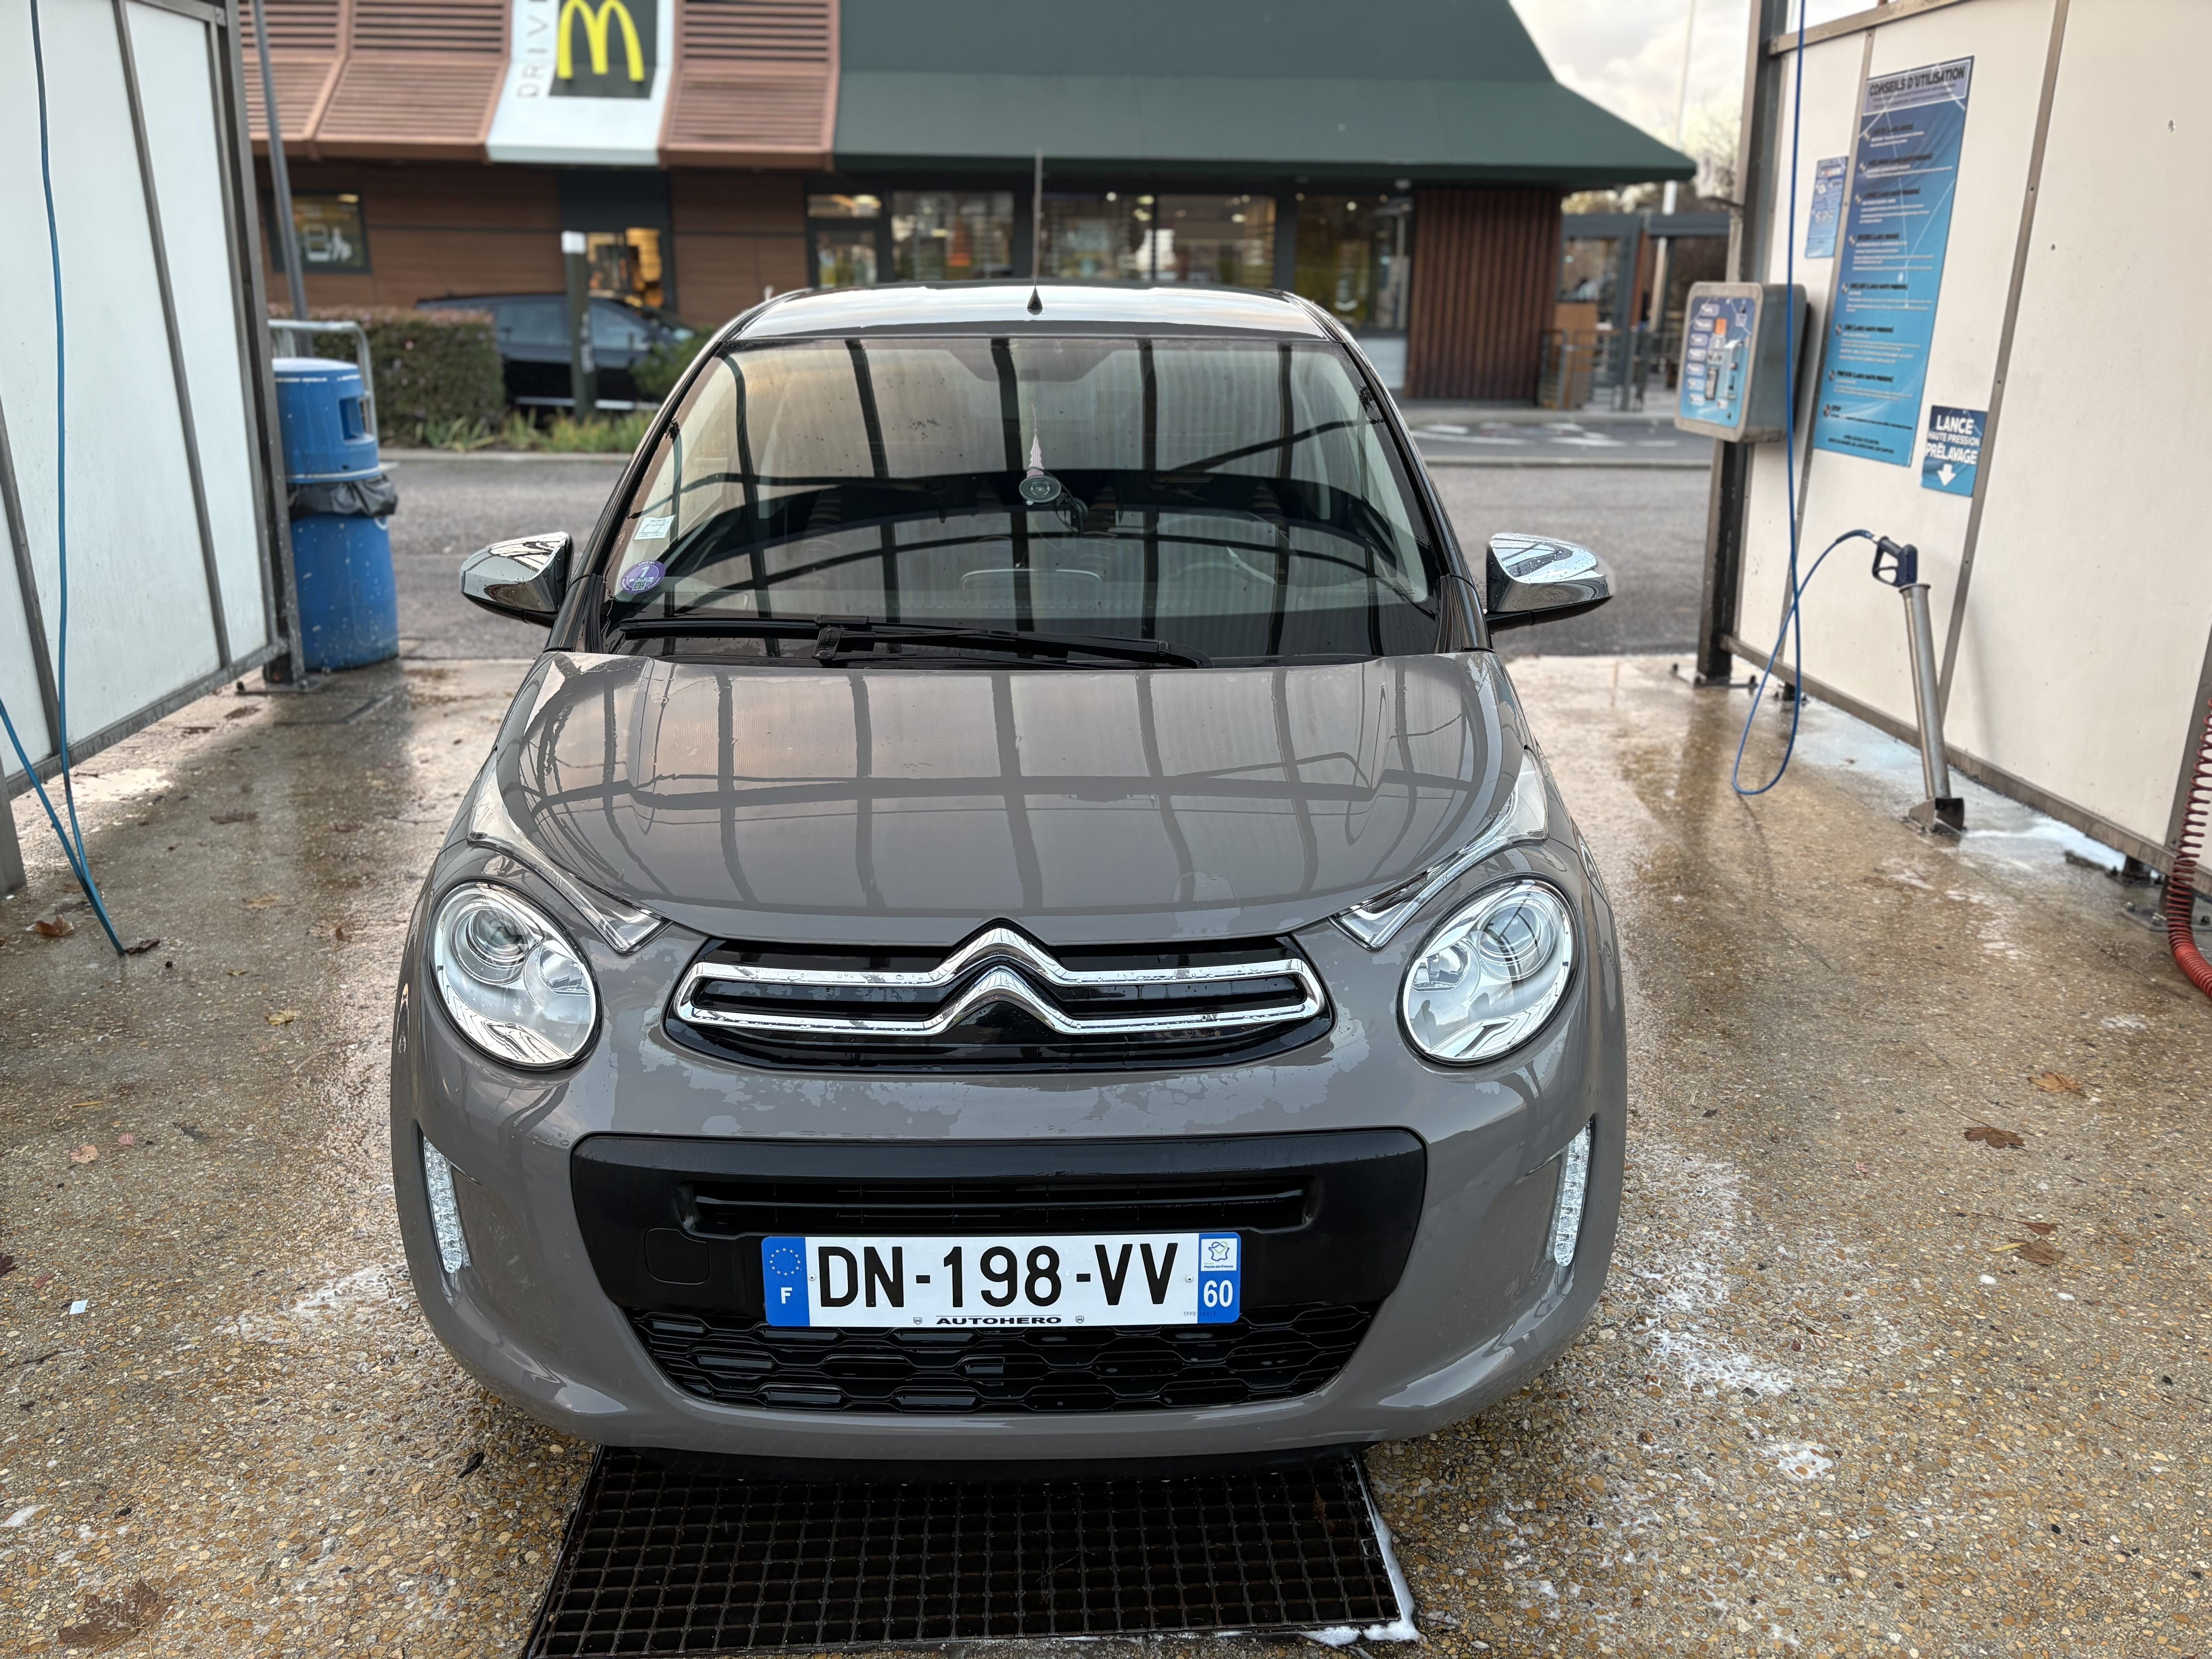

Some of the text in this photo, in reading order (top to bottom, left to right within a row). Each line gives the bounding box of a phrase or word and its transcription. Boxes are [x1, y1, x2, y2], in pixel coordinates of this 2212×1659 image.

[517, 0, 549, 98] DRIV
[1869, 77, 1906, 96] CONSEILS
[1907, 66, 1965, 89] D'UTILISATION
[1936, 415, 1974, 435] LANCE
[1928, 430, 1980, 447] HAUTE PRESSION
[640, 566, 650, 577] 1
[818, 1243, 1178, 1308] DN-198-VV
[781, 1287, 793, 1304] F
[1204, 1279, 1233, 1307] 60
